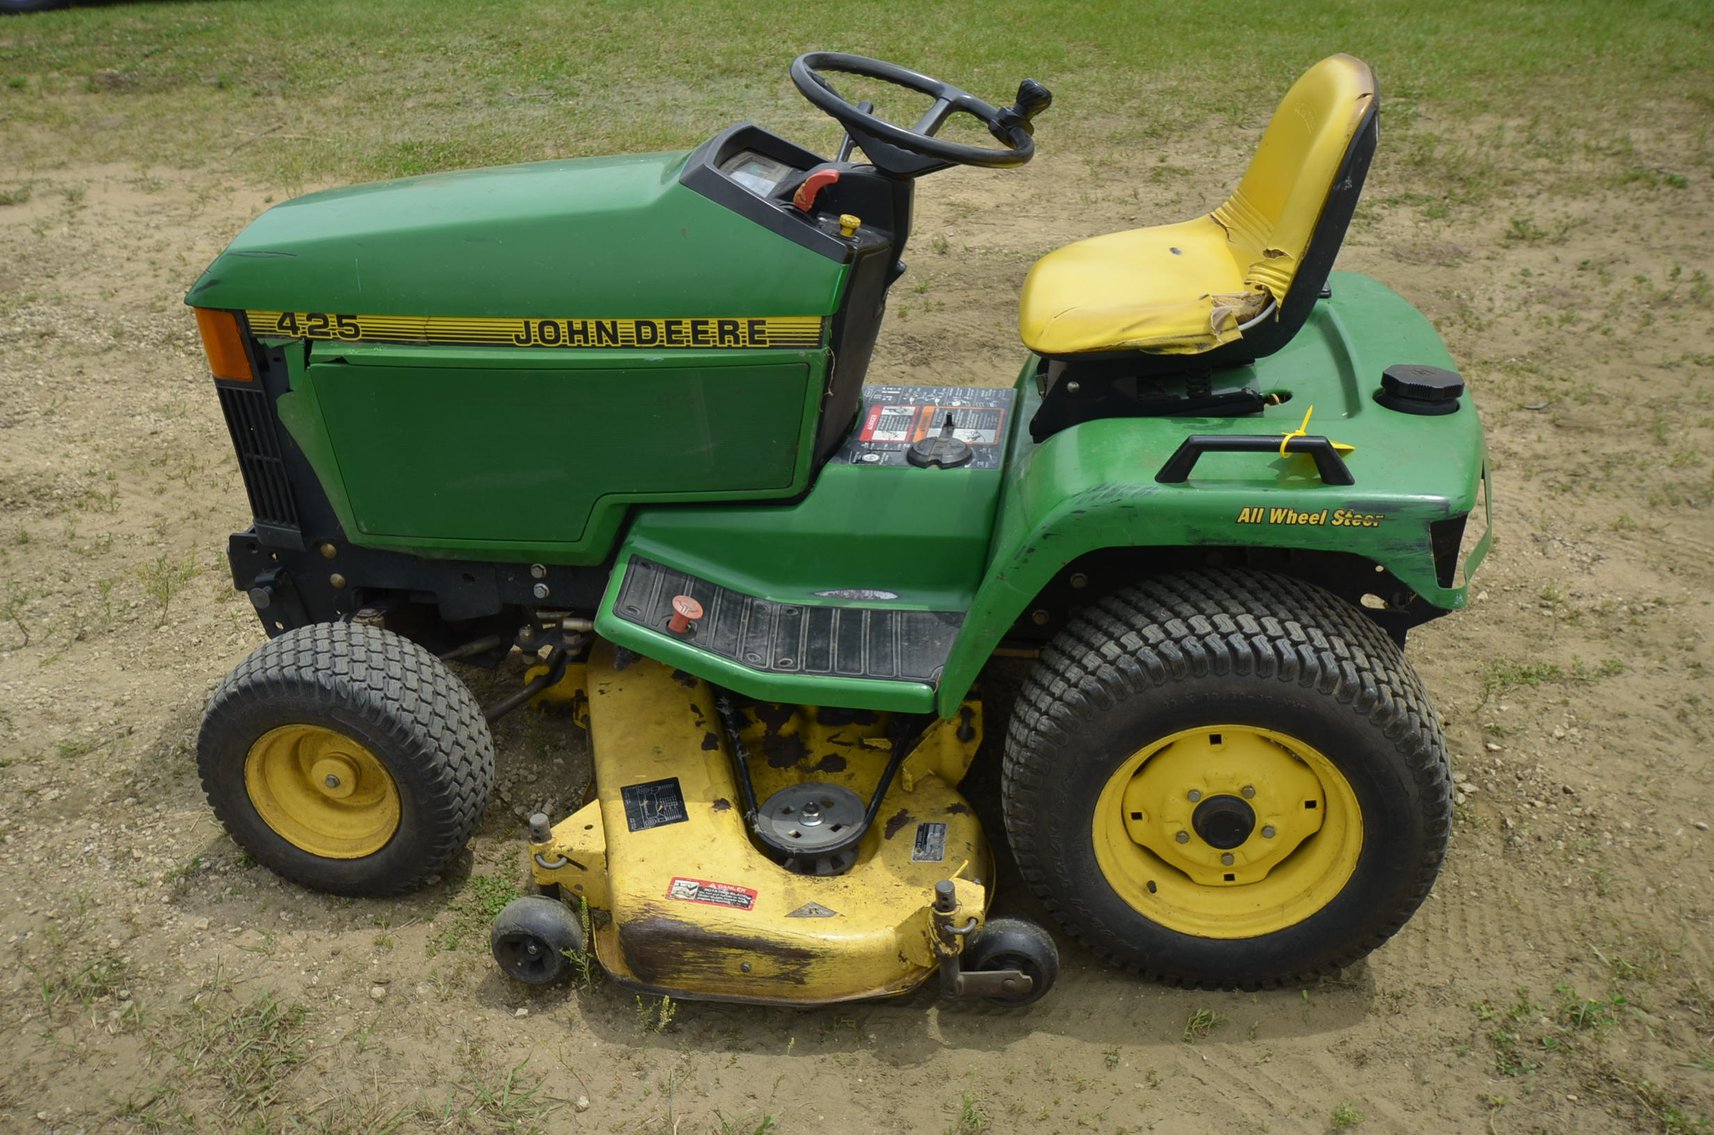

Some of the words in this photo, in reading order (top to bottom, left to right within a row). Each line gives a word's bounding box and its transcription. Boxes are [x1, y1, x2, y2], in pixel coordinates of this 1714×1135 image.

[276, 312, 362, 341] 425
[513, 319, 621, 347] JOHN
[634, 319, 770, 348] DEERE
[1237, 507, 1265, 524] All
[1269, 507, 1328, 526] Wheel
